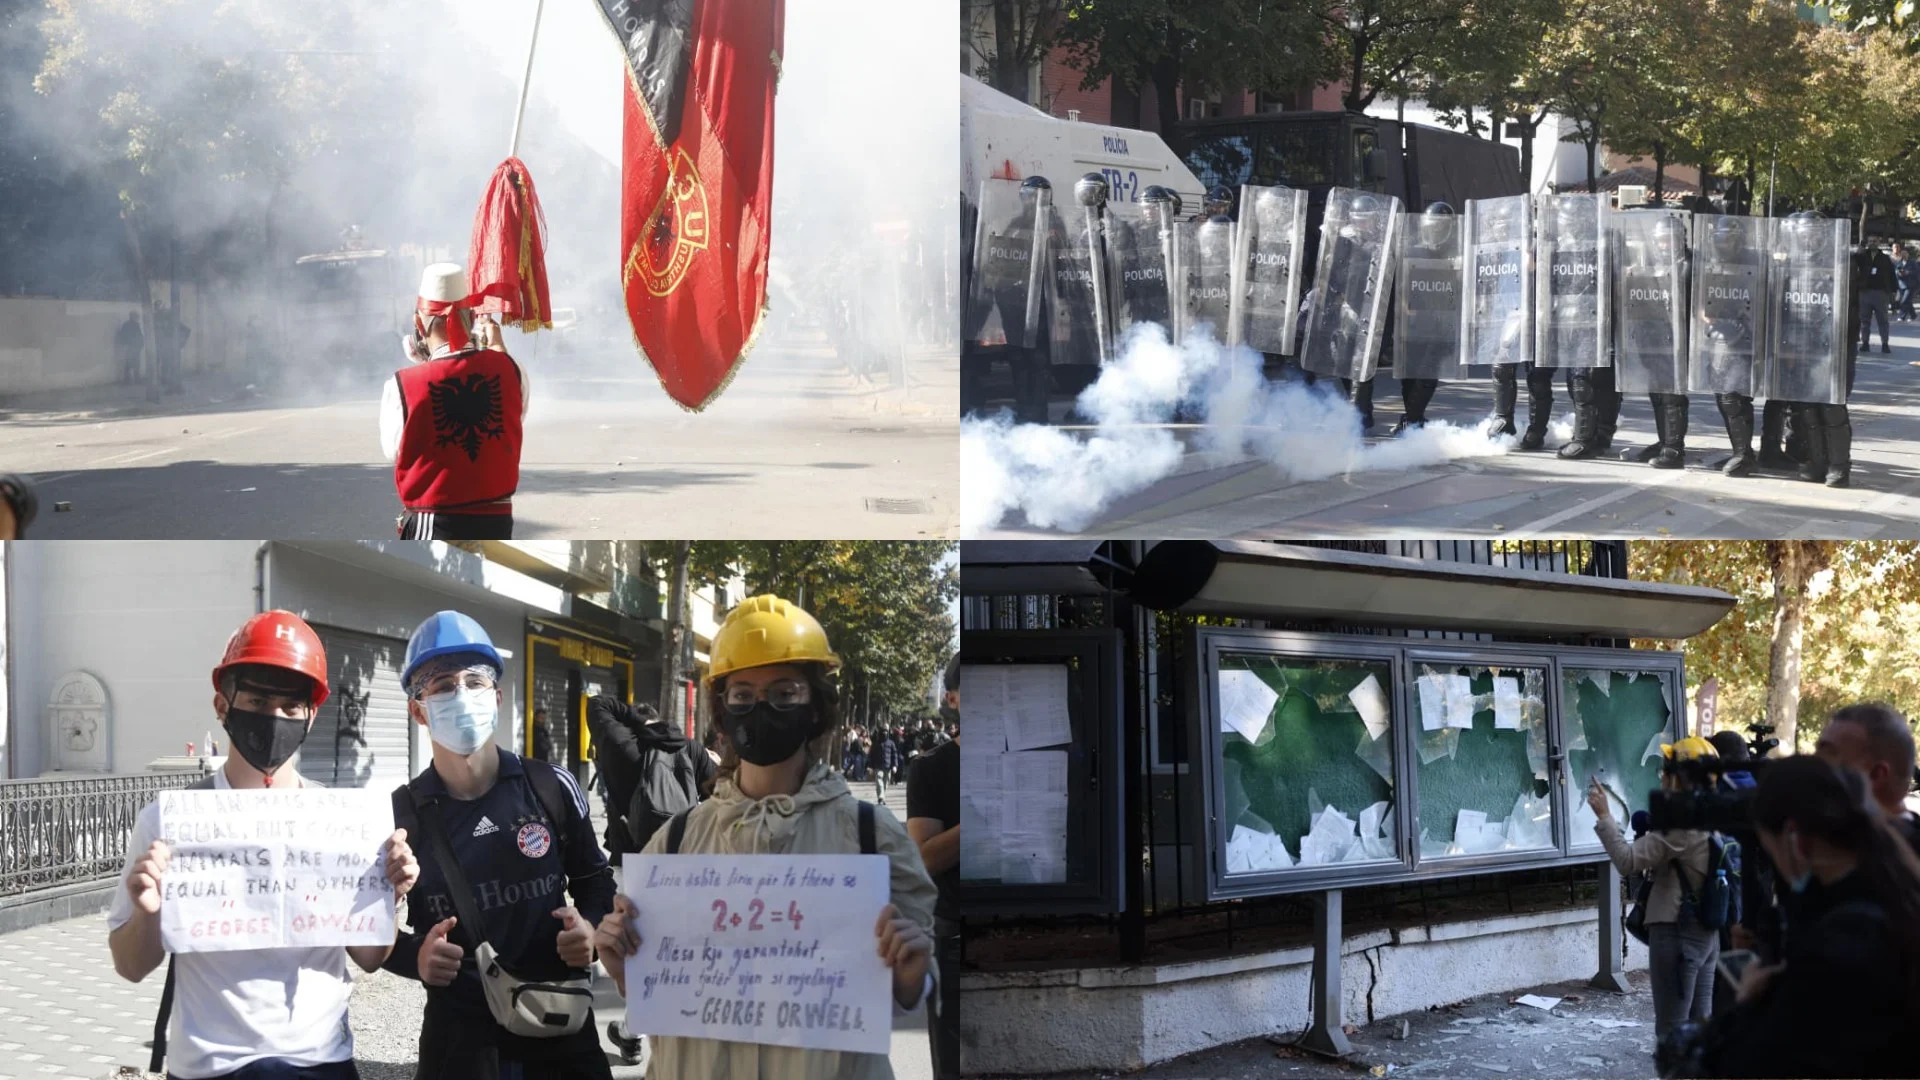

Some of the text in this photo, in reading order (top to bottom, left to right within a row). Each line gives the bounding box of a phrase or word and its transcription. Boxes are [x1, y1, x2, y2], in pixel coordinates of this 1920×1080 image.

[1103, 136, 1129, 155] POLICIA
[1102, 168, 1138, 203] TR-2
[990, 247, 1029, 261] POLICIA
[1250, 252, 1287, 266] POLICIA
[1058, 270, 1091, 282] POLICIA
[1124, 269, 1164, 282] POLICIA
[1478, 262, 1519, 276] POLICIA
[1552, 262, 1595, 277] POLICIA
[1189, 287, 1228, 299] POLICIA
[1411, 280, 1454, 293] POLICIA
[1708, 285, 1750, 300] POLICIA
[1629, 288, 1670, 302] POLICIA
[1784, 291, 1830, 306] POLICIA
[473, 824, 500, 837] adidas
[283, 844, 322, 868] ARE
[165, 879, 228, 901] EQUAL
[246, 876, 297, 894] THAN
[476, 872, 559, 911] Home
[291, 914, 377, 936] ORWELL
